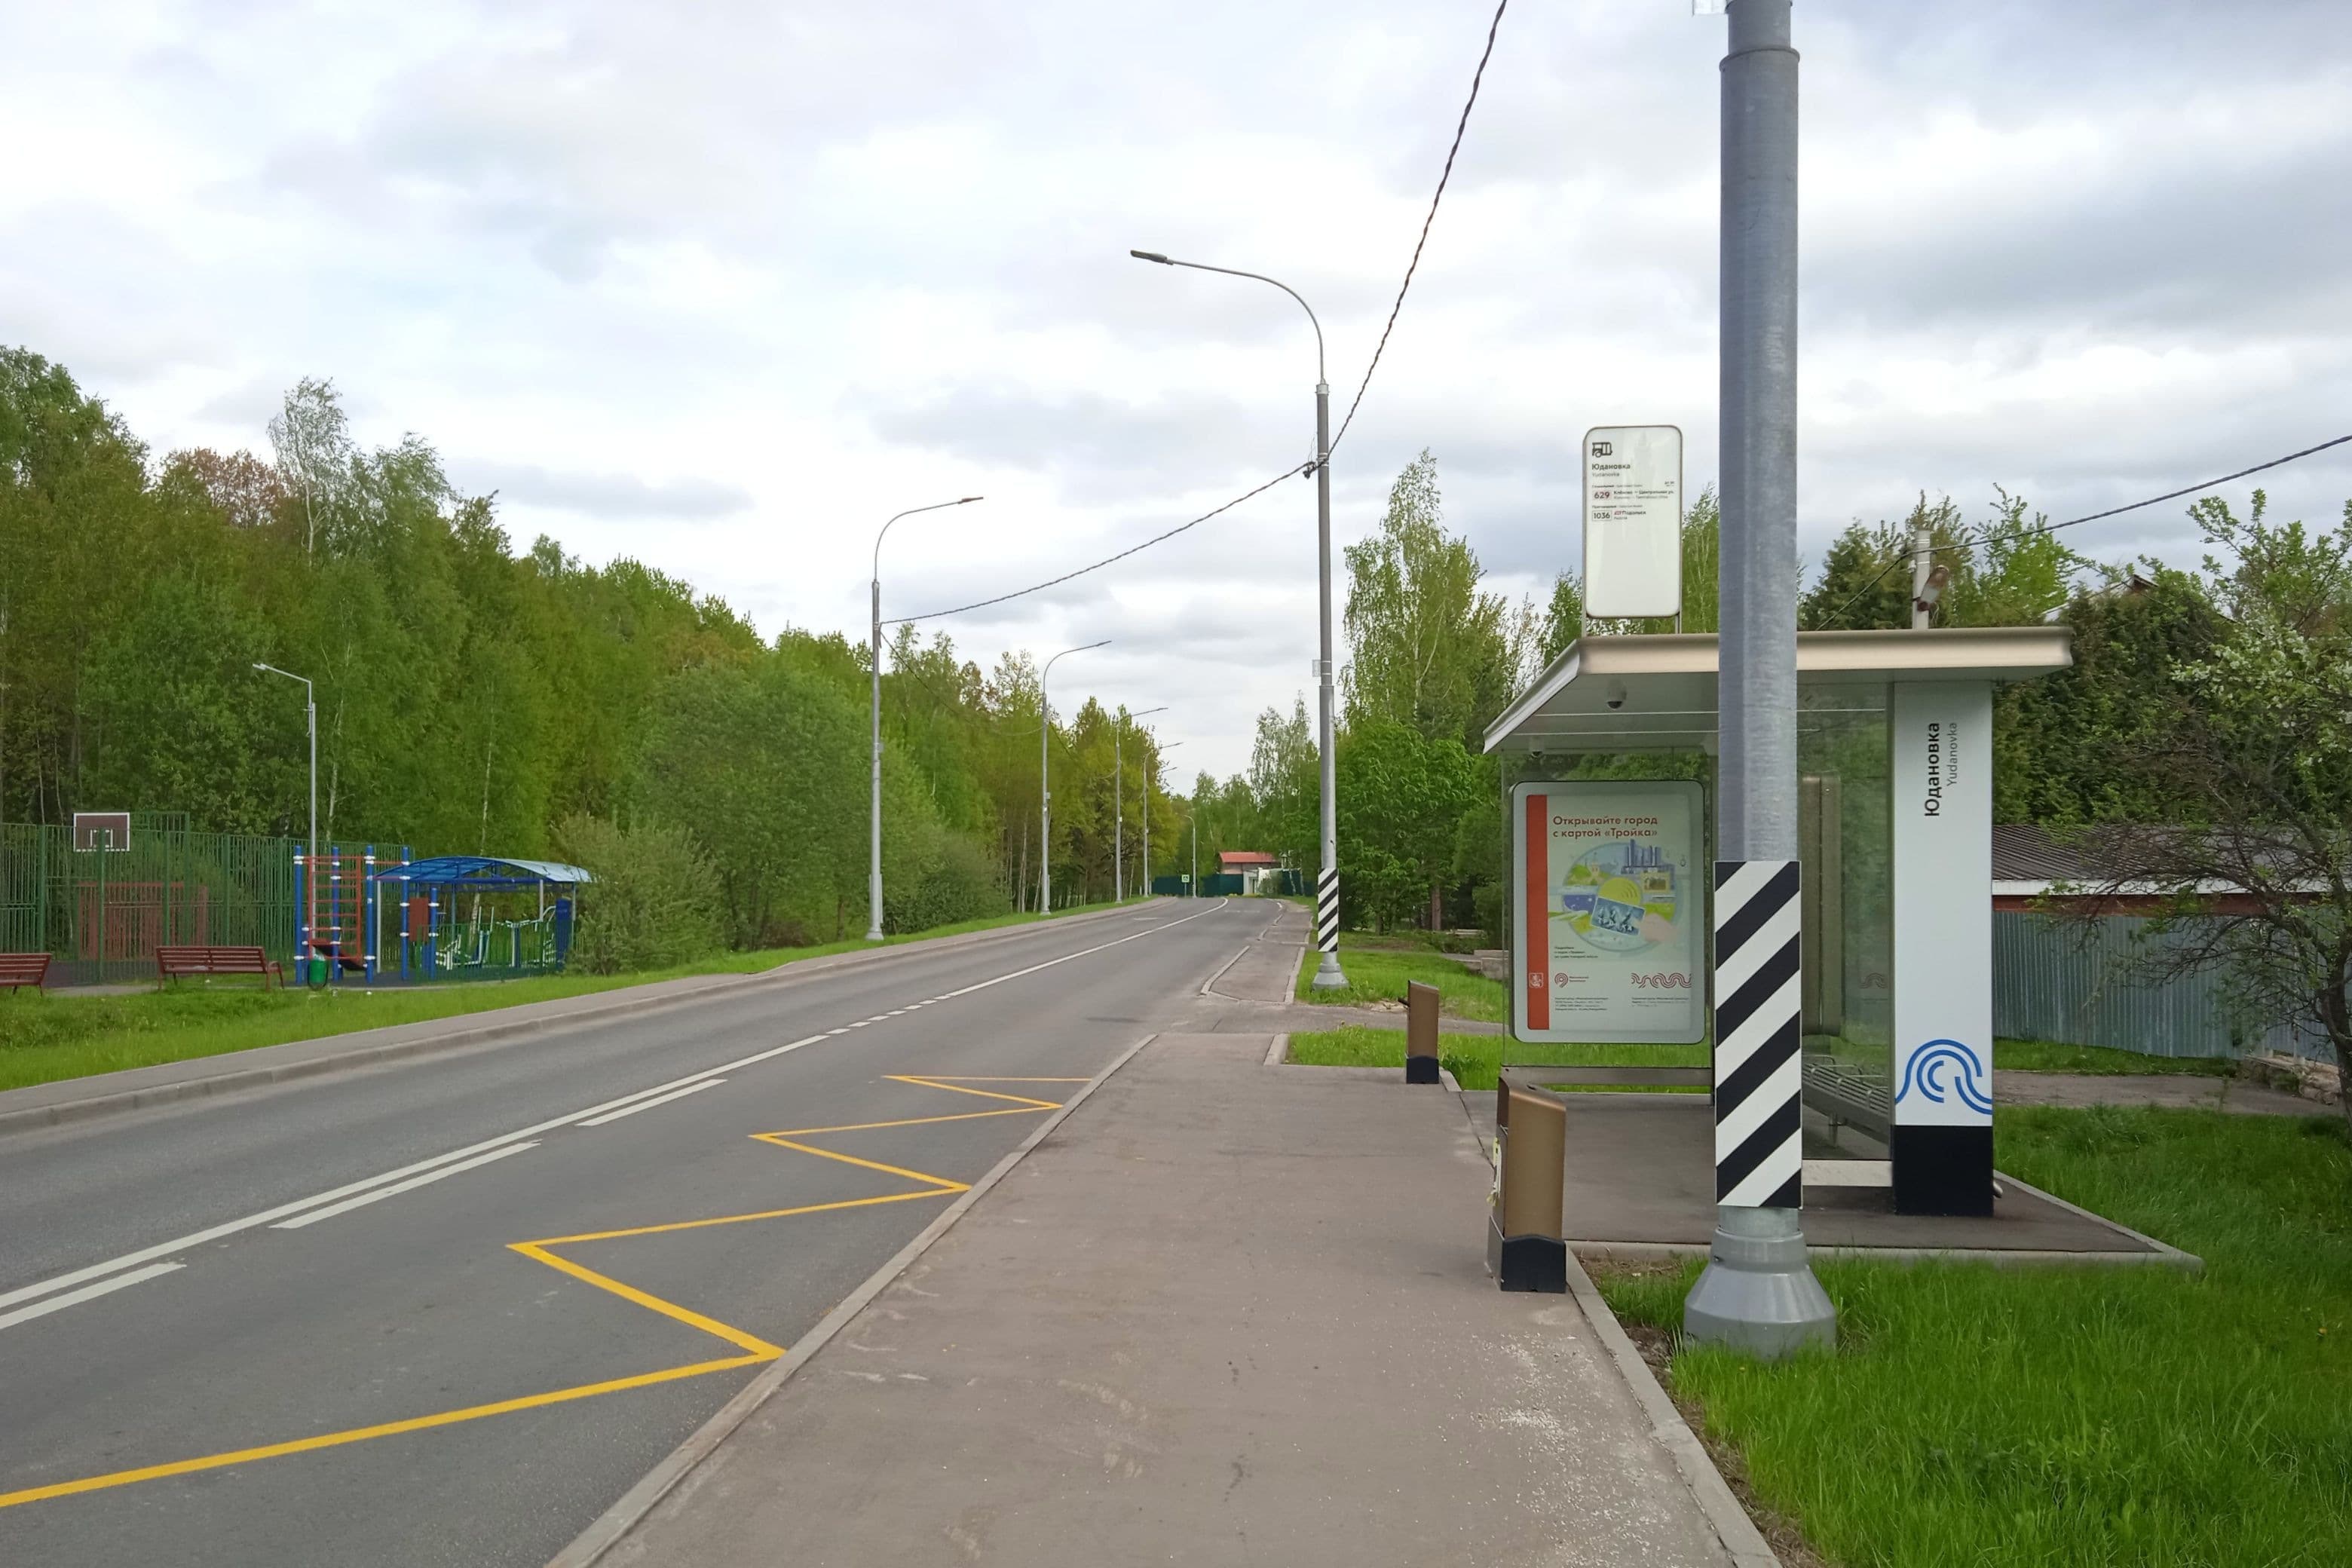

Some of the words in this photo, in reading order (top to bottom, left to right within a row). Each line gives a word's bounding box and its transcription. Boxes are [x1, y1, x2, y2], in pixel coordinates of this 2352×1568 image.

[1924, 723, 1942, 816] Юдановка
[1946, 722, 1958, 786] Yudanovka
[1553, 816, 1622, 827] Открывайте
[1625, 817, 1658, 826] город
[1561, 828, 1601, 839] картой
[1604, 828, 1658, 838] «Тройка»
